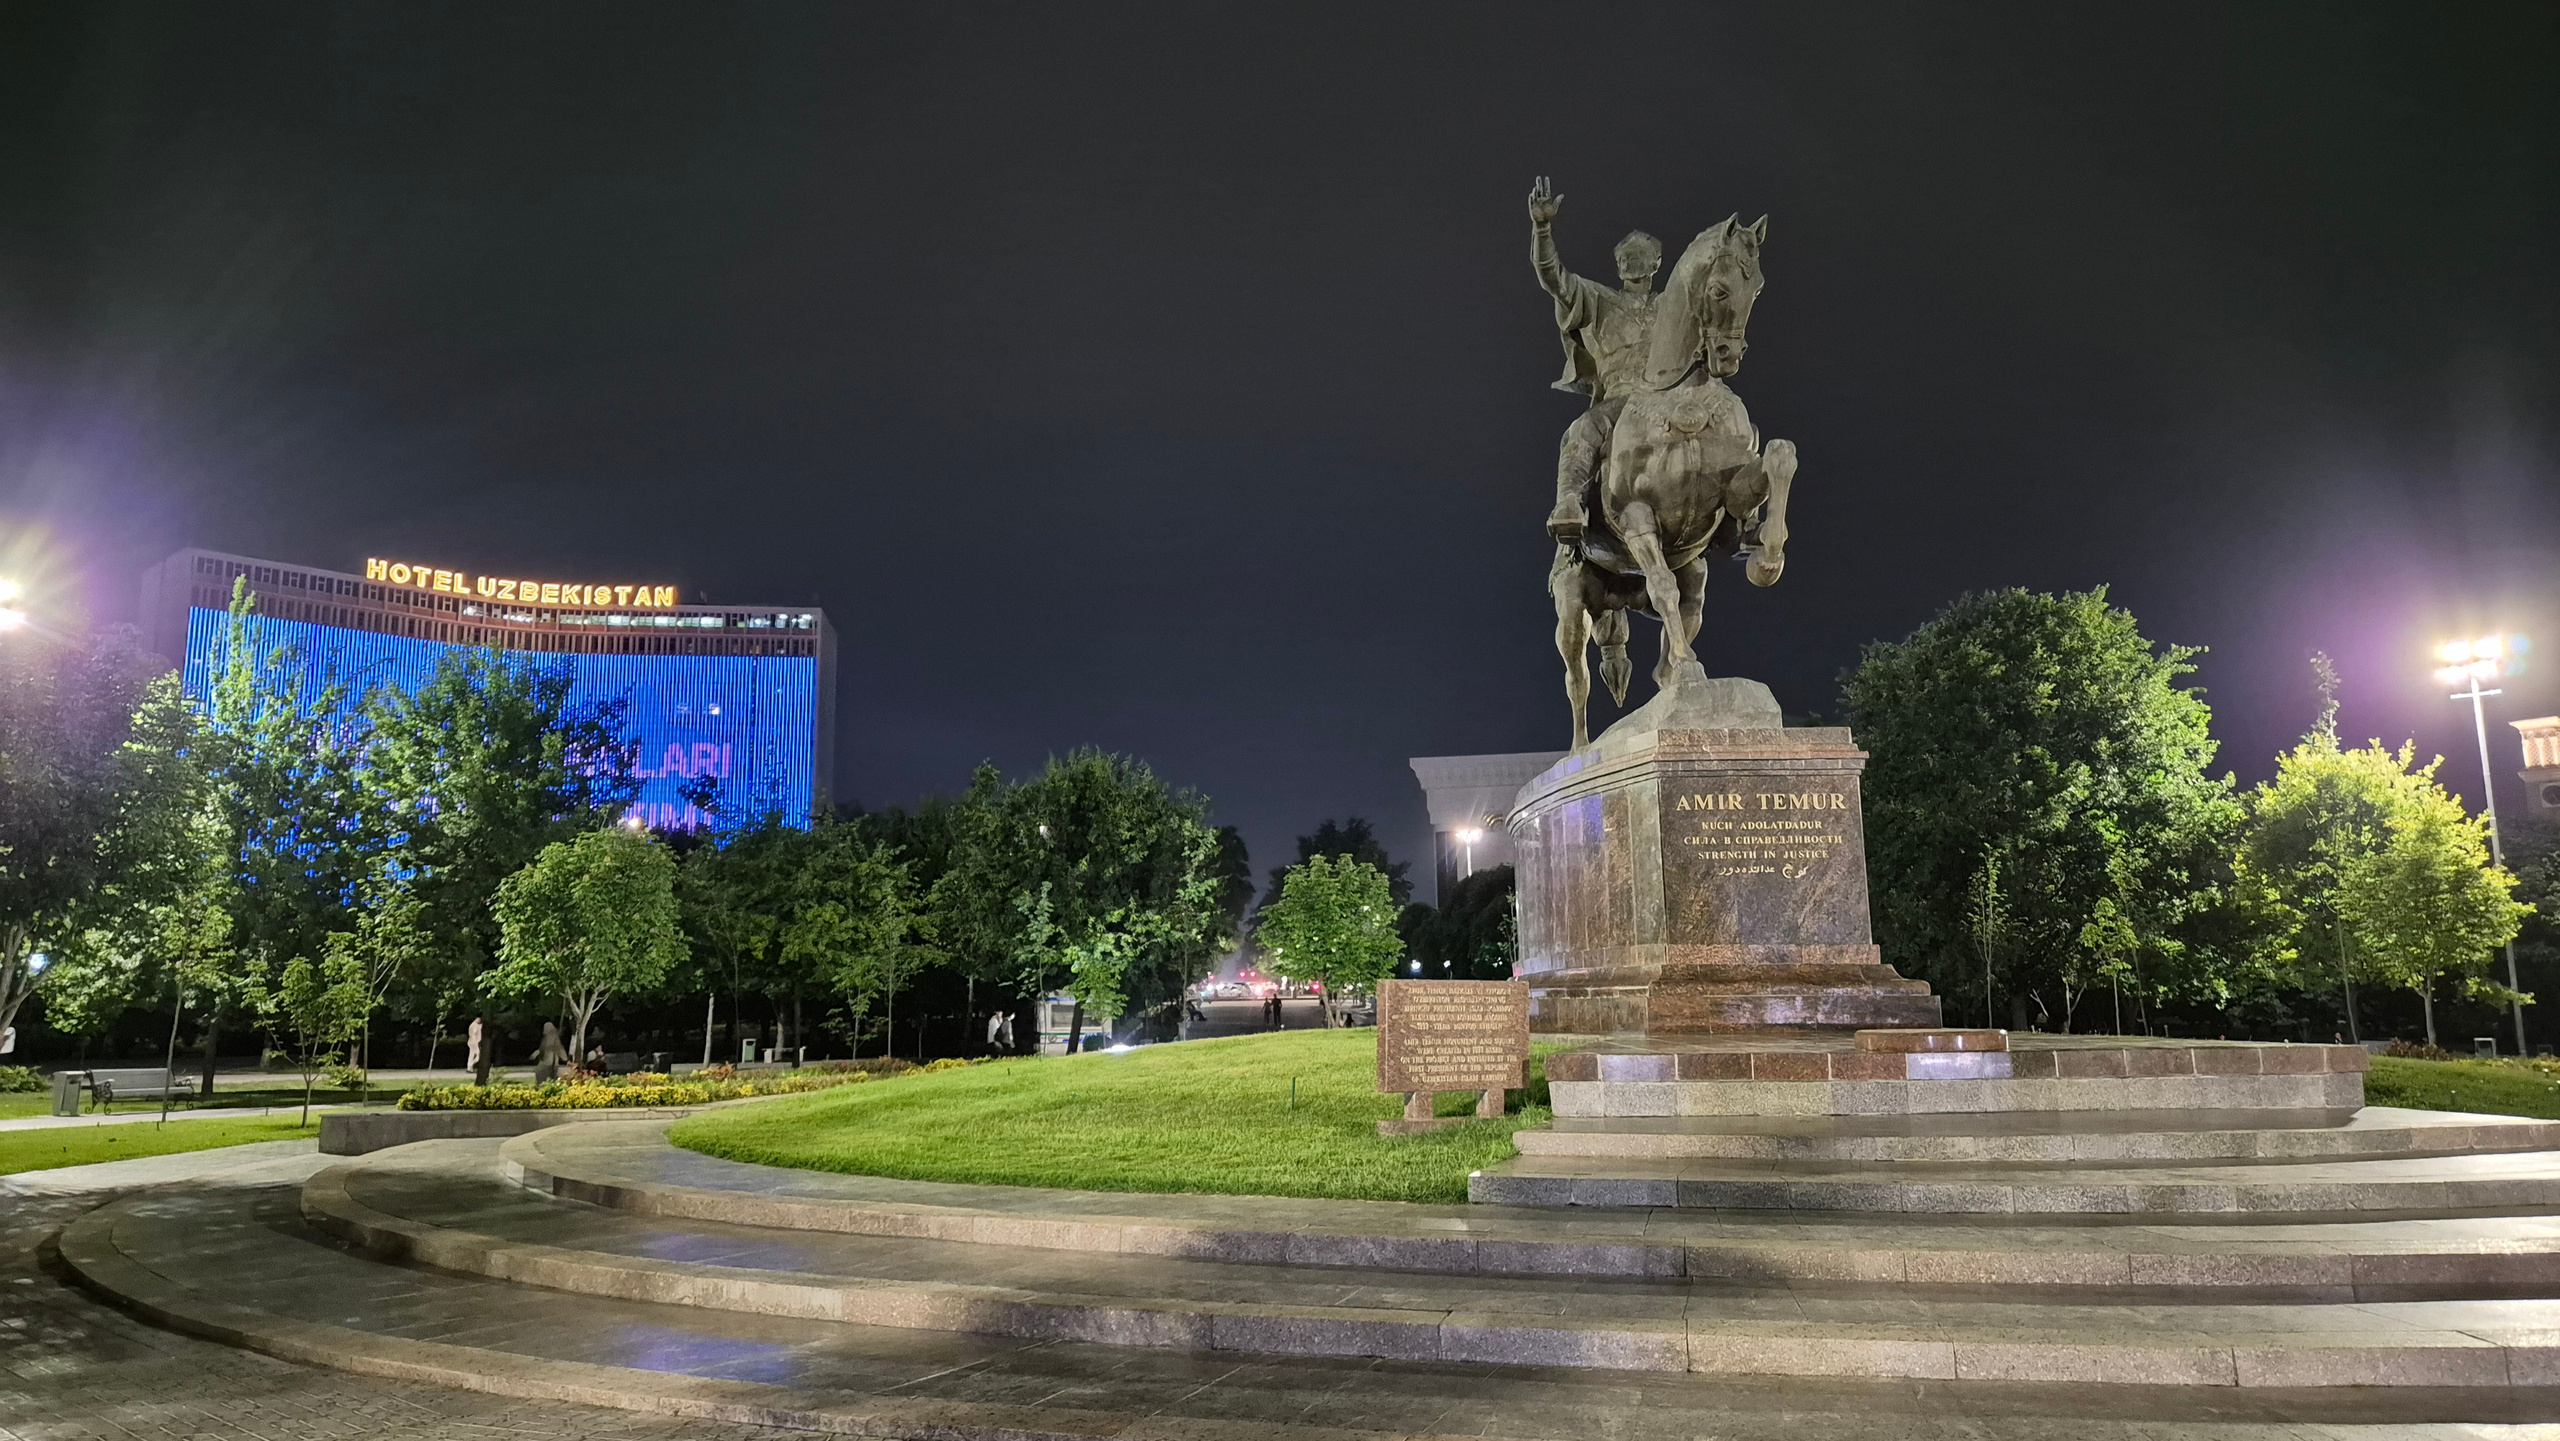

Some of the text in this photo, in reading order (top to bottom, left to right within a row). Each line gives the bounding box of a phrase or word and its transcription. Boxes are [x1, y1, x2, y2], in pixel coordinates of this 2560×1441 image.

[365, 558, 677, 608] HOTEL UZBEKISTAN
[1676, 793, 1846, 811] AMIR TEMUR
[1702, 821, 1822, 830] KUCH ADOLATDADUR
[1684, 835, 1843, 845] СИЛА В СПРАВЕДЛИВОСТИ
[1698, 850, 1829, 859] STRENGTH IN JUSTICE
